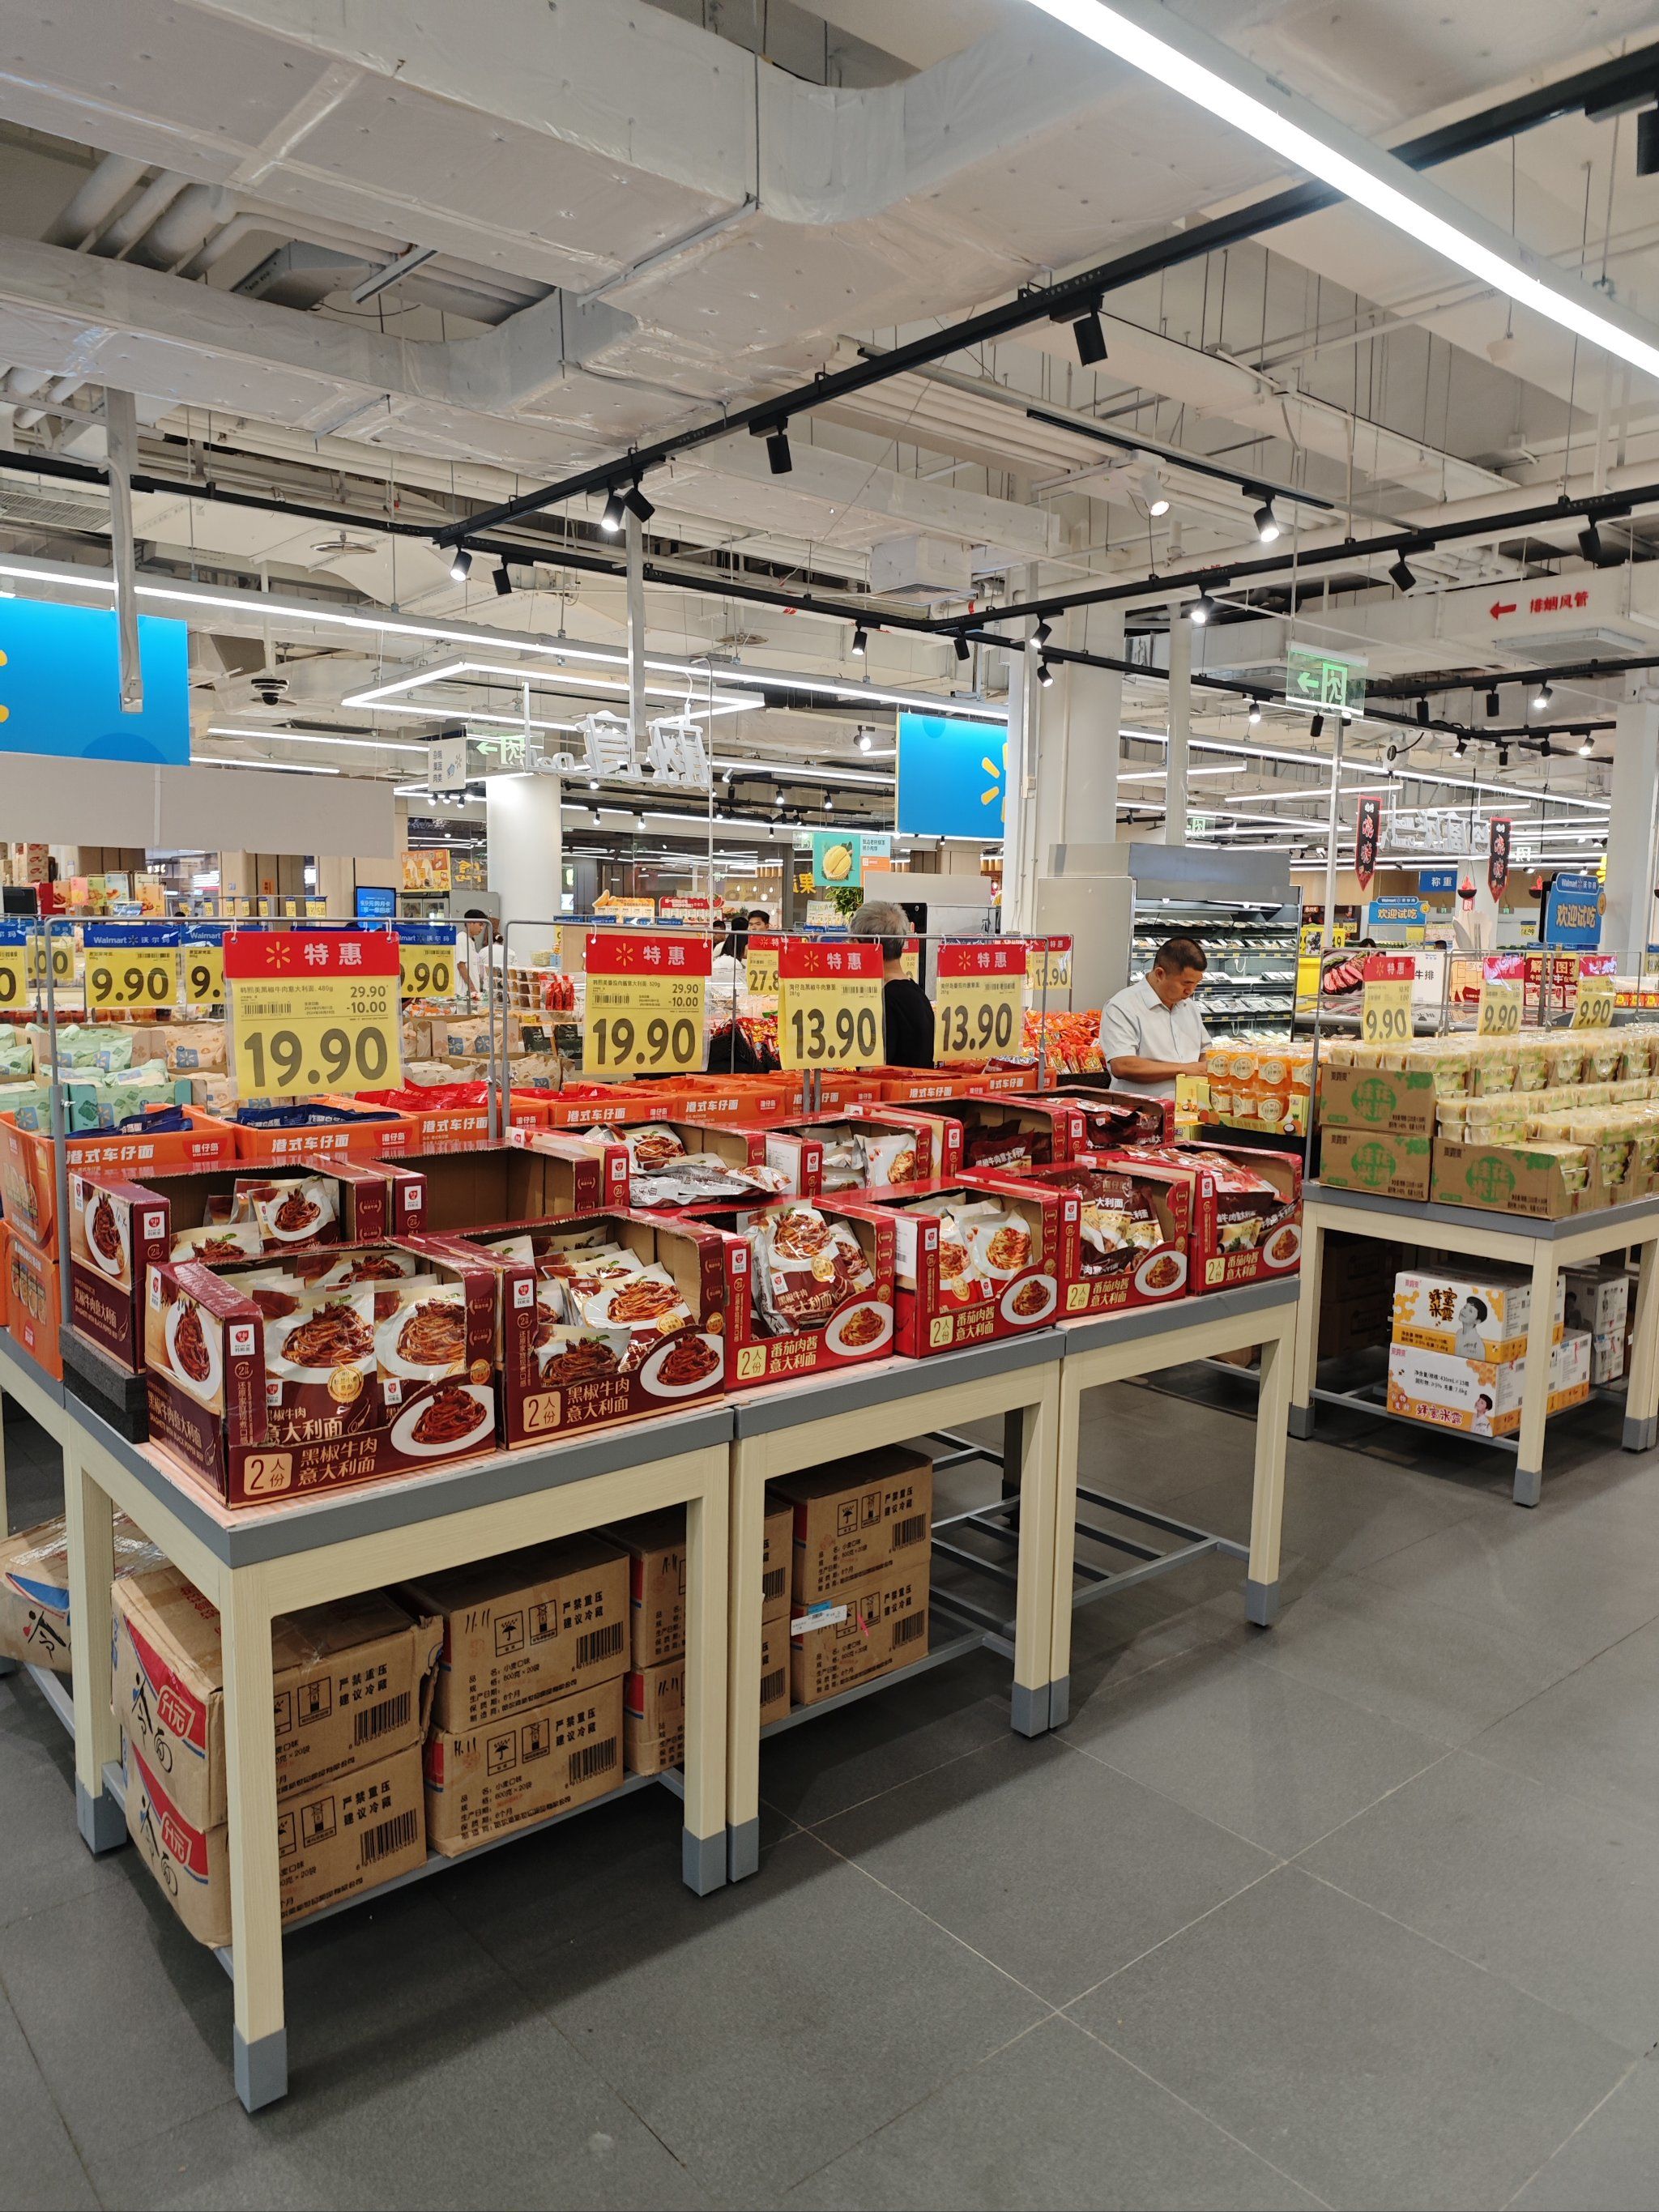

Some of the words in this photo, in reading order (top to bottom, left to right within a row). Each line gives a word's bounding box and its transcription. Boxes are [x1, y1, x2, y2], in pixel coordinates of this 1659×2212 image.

[1529, 591, 1589, 614] 排烟风管
[1431, 876, 1452, 887] 称重
[1562, 878, 1578, 888] Walmart
[1583, 881, 1597, 890] 沃尔玛
[1377, 908, 1418, 920] 欢迎试吃
[1555, 904, 1597, 928] 欢迎试吃
[93, 936, 127, 944] Walmart
[141, 936, 171, 944] 沃尔玛
[190, 931, 221, 940] Walmart
[1049, 939, 1064, 948] 特惠
[304, 943, 362, 965] 特惠
[642, 945, 685, 965] 特惠
[826, 952, 862, 970] 特惠
[977, 952, 1007, 969] 特惠
[1387, 962, 1405, 976] 特惠
[1415, 970, 1435, 981] 牛排
[92, 967, 168, 1002] 9.90
[191, 965, 225, 999] 9.
[350, 986, 386, 998] 29.90
[672, 983, 699, 994] 29.90
[347, 1001, 386, 1013] -10.00
[668, 996, 698, 1007] -10.00
[1580, 999, 1611, 1025] 9.90
[941, 1003, 1013, 1051] 13.90
[1366, 1008, 1407, 1040] 9.90
[1483, 1004, 1517, 1033] 9.90
[592, 1017, 695, 1066] 19.90
[791, 1008, 876, 1059] 13.90
[244, 1026, 387, 1088] 19.90
[909, 1086, 952, 1098] 港式车仔面
[567, 1107, 626, 1123] 港式车仔面
[686, 1099, 739, 1113] 港式车仔面
[422, 1116, 488, 1133] 港式车仔面
[66, 1144, 155, 1165] 港式车仔面
[271, 1134, 350, 1153] 港式车仔面
[1209, 1261, 1215, 1281] 2
[1216, 1261, 1223, 1281] 人份
[1070, 1286, 1079, 1308] 2
[1079, 1286, 1087, 1306] 人份
[1428, 1287, 1458, 1308] 蜂蜜
[956, 1306, 996, 1328] 番茄肉酱
[1429, 1304, 1455, 1322] 米露
[933, 1321, 941, 1344] 2
[942, 1319, 950, 1342] 人份
[955, 1320, 995, 1343] 意大利面
[770, 1336, 819, 1359] 番茄肉酱
[741, 1350, 751, 1376] 2
[752, 1349, 762, 1374] 人份
[770, 1350, 817, 1375] 意大利面
[567, 1378, 630, 1404] 黑椒牛肉
[528, 1399, 540, 1428] 2
[543, 1396, 557, 1425] 人份
[566, 1394, 629, 1423] 意大利面
[1416, 1404, 1464, 1426] 蜂蜜米露
[147, 1390, 203, 1450] 黑椒牛肉意大利面
[301, 1437, 378, 1468] 黑椒牛肉
[250, 1459, 265, 1490] 2
[270, 1458, 286, 1488] 人份
[298, 1455, 376, 1487] 意大利面
[885, 1486, 914, 1504] 严禁重压
[562, 1591, 603, 1614] 严禁重压
[884, 1584, 912, 1604] 严禁重压
[563, 1605, 604, 1630] 建议冷藏
[504, 1657, 531, 1673] 小麦口味
[339, 1663, 388, 1692] 严禁重压
[339, 1678, 388, 1707] 建议冷藏
[555, 1707, 597, 1733] 严禁重压
[556, 1721, 597, 1747] 建议冷藏
[342, 1779, 391, 1810] 严禁重压
[495, 1775, 522, 1792] 小麦口味
[343, 1795, 392, 1826] 建议冷藏
